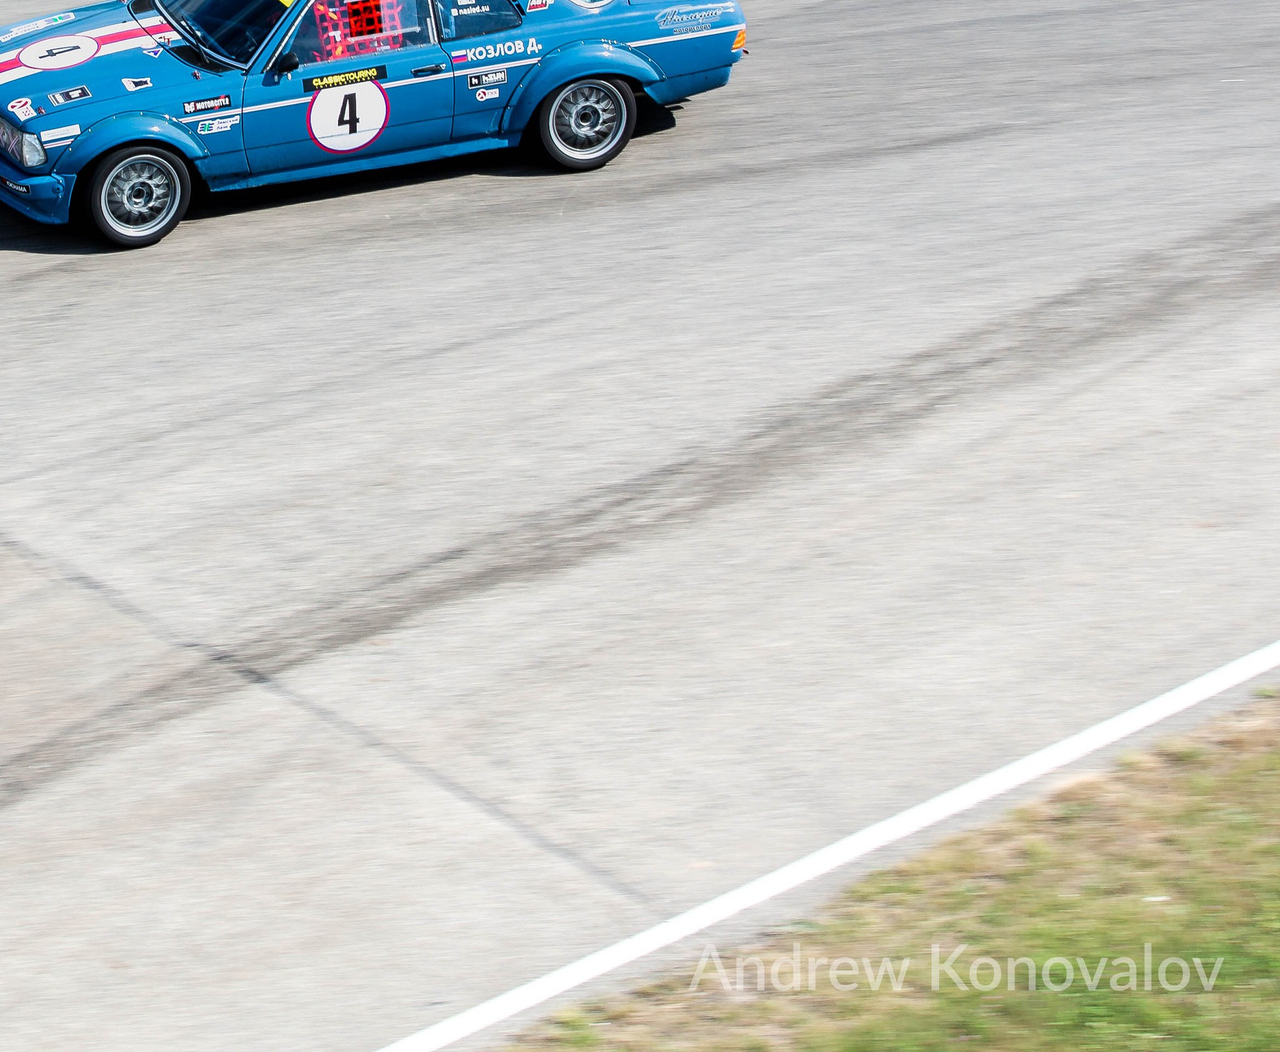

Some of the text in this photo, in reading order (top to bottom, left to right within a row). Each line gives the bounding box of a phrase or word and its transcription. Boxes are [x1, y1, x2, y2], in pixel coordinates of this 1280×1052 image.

[38, 45, 81, 59] 4
[467, 37, 543, 62] КОЗЛОВ Д.
[337, 92, 360, 135] 4
